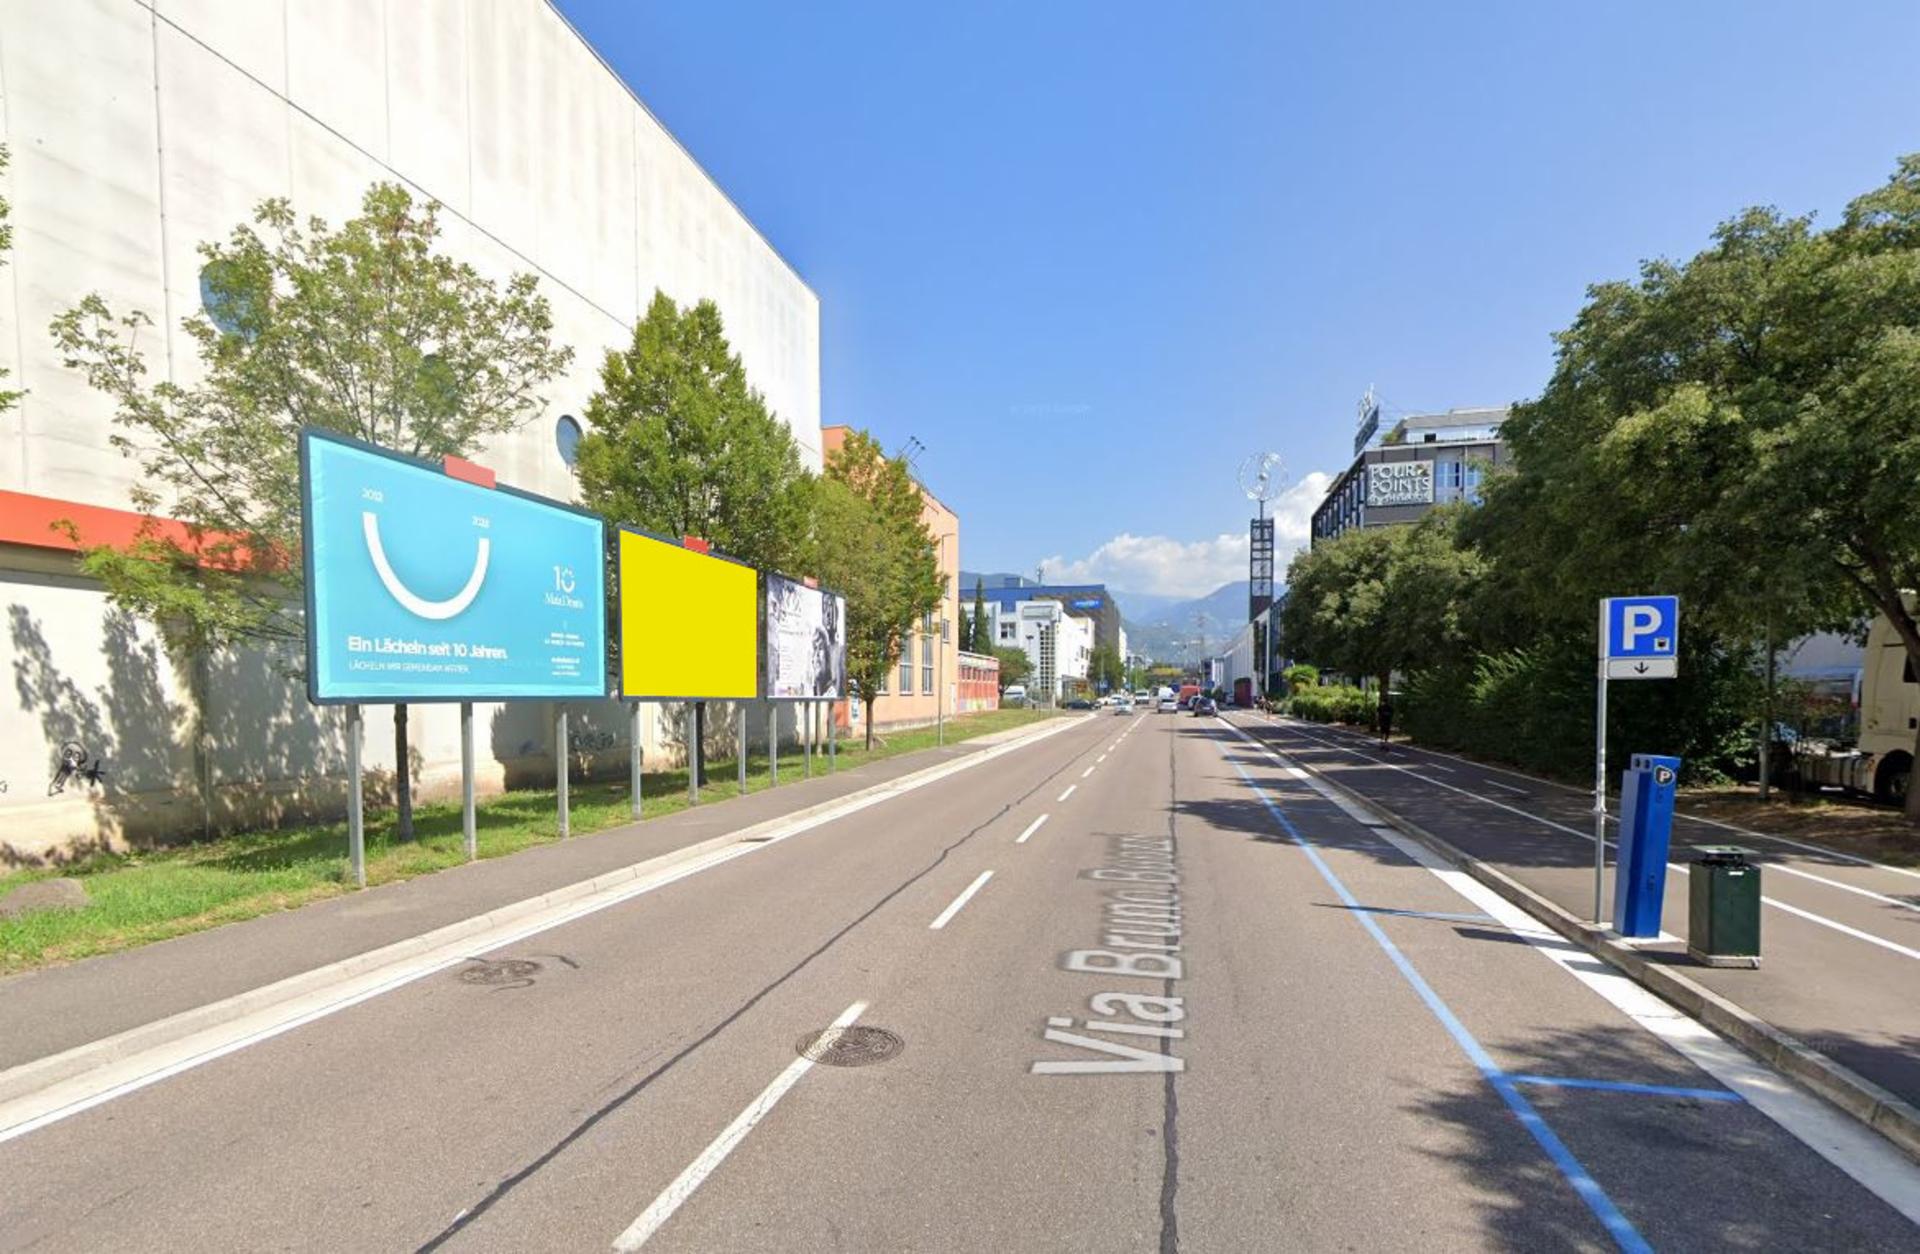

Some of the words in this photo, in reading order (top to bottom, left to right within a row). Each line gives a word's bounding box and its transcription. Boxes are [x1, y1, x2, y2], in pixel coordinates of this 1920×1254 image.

[1371, 476, 1430, 493] POINTS
[1623, 605, 1662, 651] P
[347, 635, 372, 652] Ein
[374, 637, 426, 655] Lächeln
[428, 641, 450, 656] seit
[453, 643, 467, 658] 10
[1660, 770, 1671, 782] P
